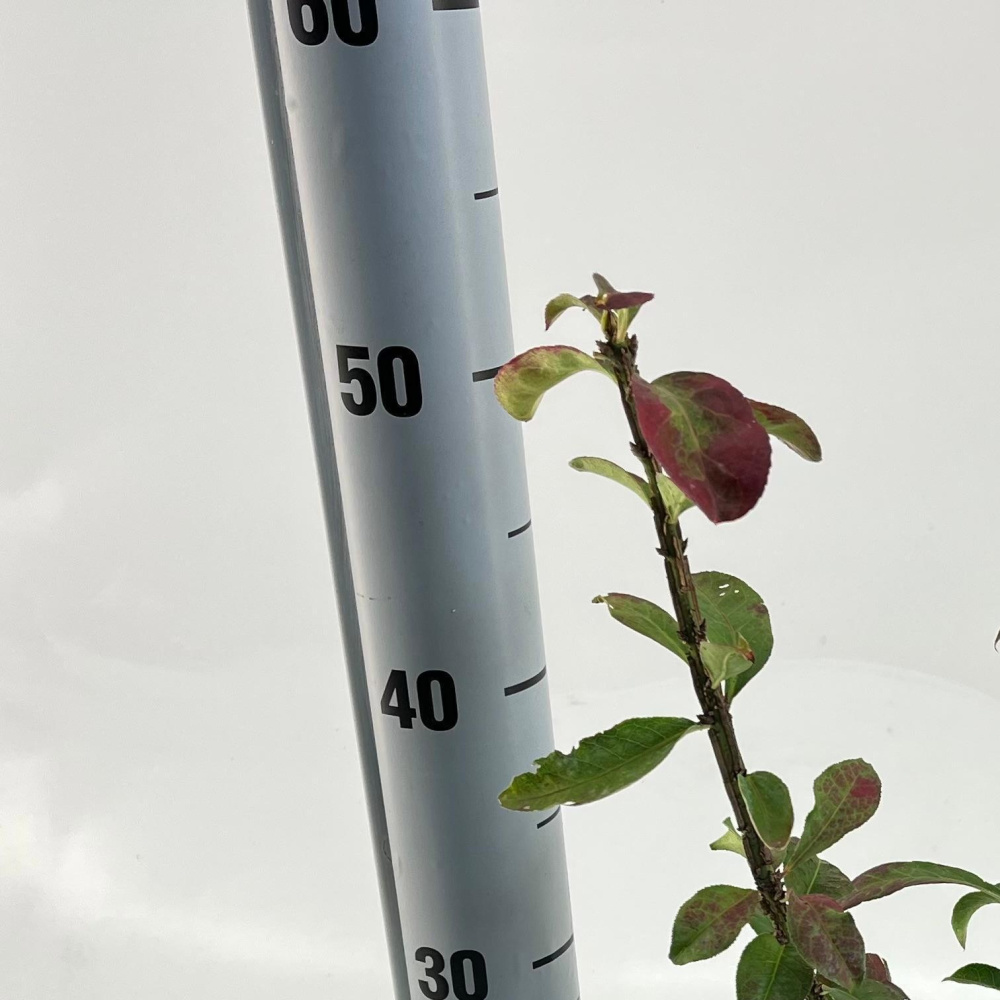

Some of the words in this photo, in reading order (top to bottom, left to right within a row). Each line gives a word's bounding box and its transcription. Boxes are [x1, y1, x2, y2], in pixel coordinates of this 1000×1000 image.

[286, 0, 379, 47] 60
[337, 345, 422, 417] 50
[381, 670, 459, 732] 40
